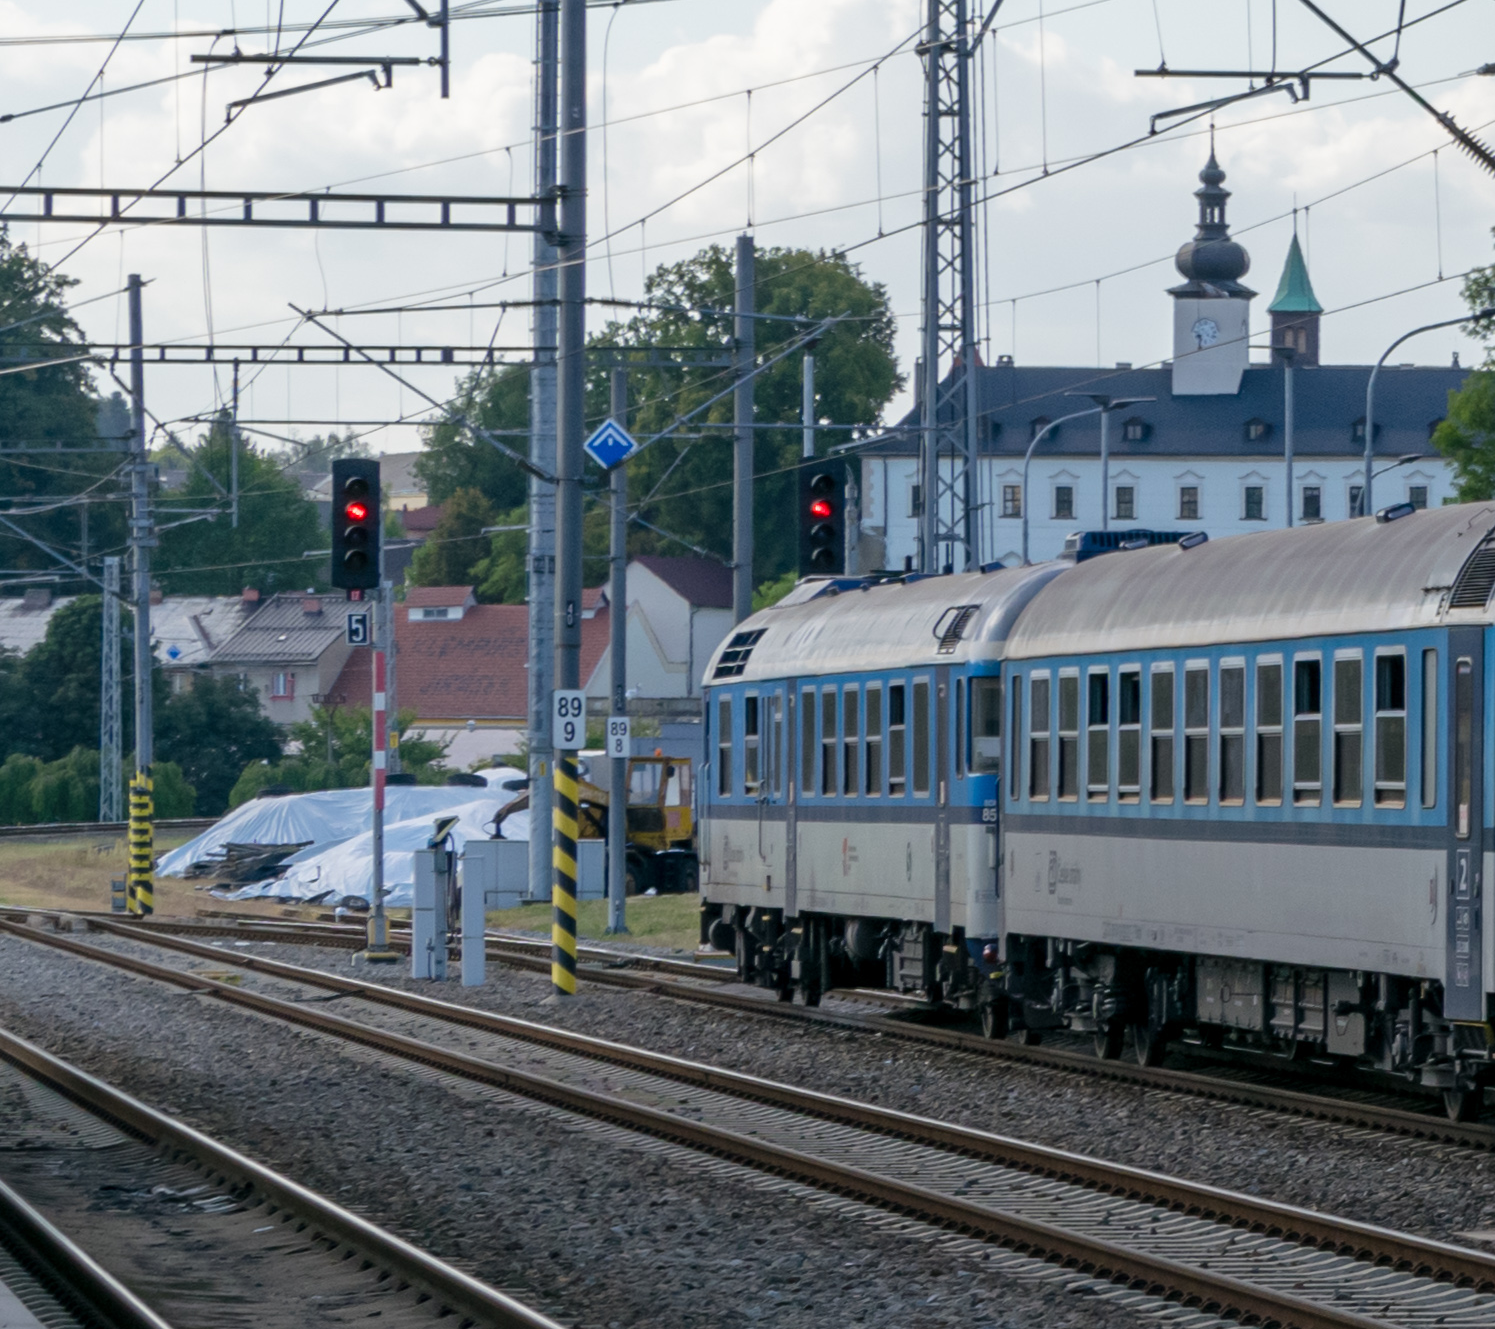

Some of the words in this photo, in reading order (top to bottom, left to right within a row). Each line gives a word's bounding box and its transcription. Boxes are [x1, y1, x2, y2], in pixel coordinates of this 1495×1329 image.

[351, 615, 363, 642] 5
[557, 696, 582, 718] 89
[563, 721, 575, 742] 9
[610, 721, 627, 737] 89
[615, 738, 623, 753] 8
